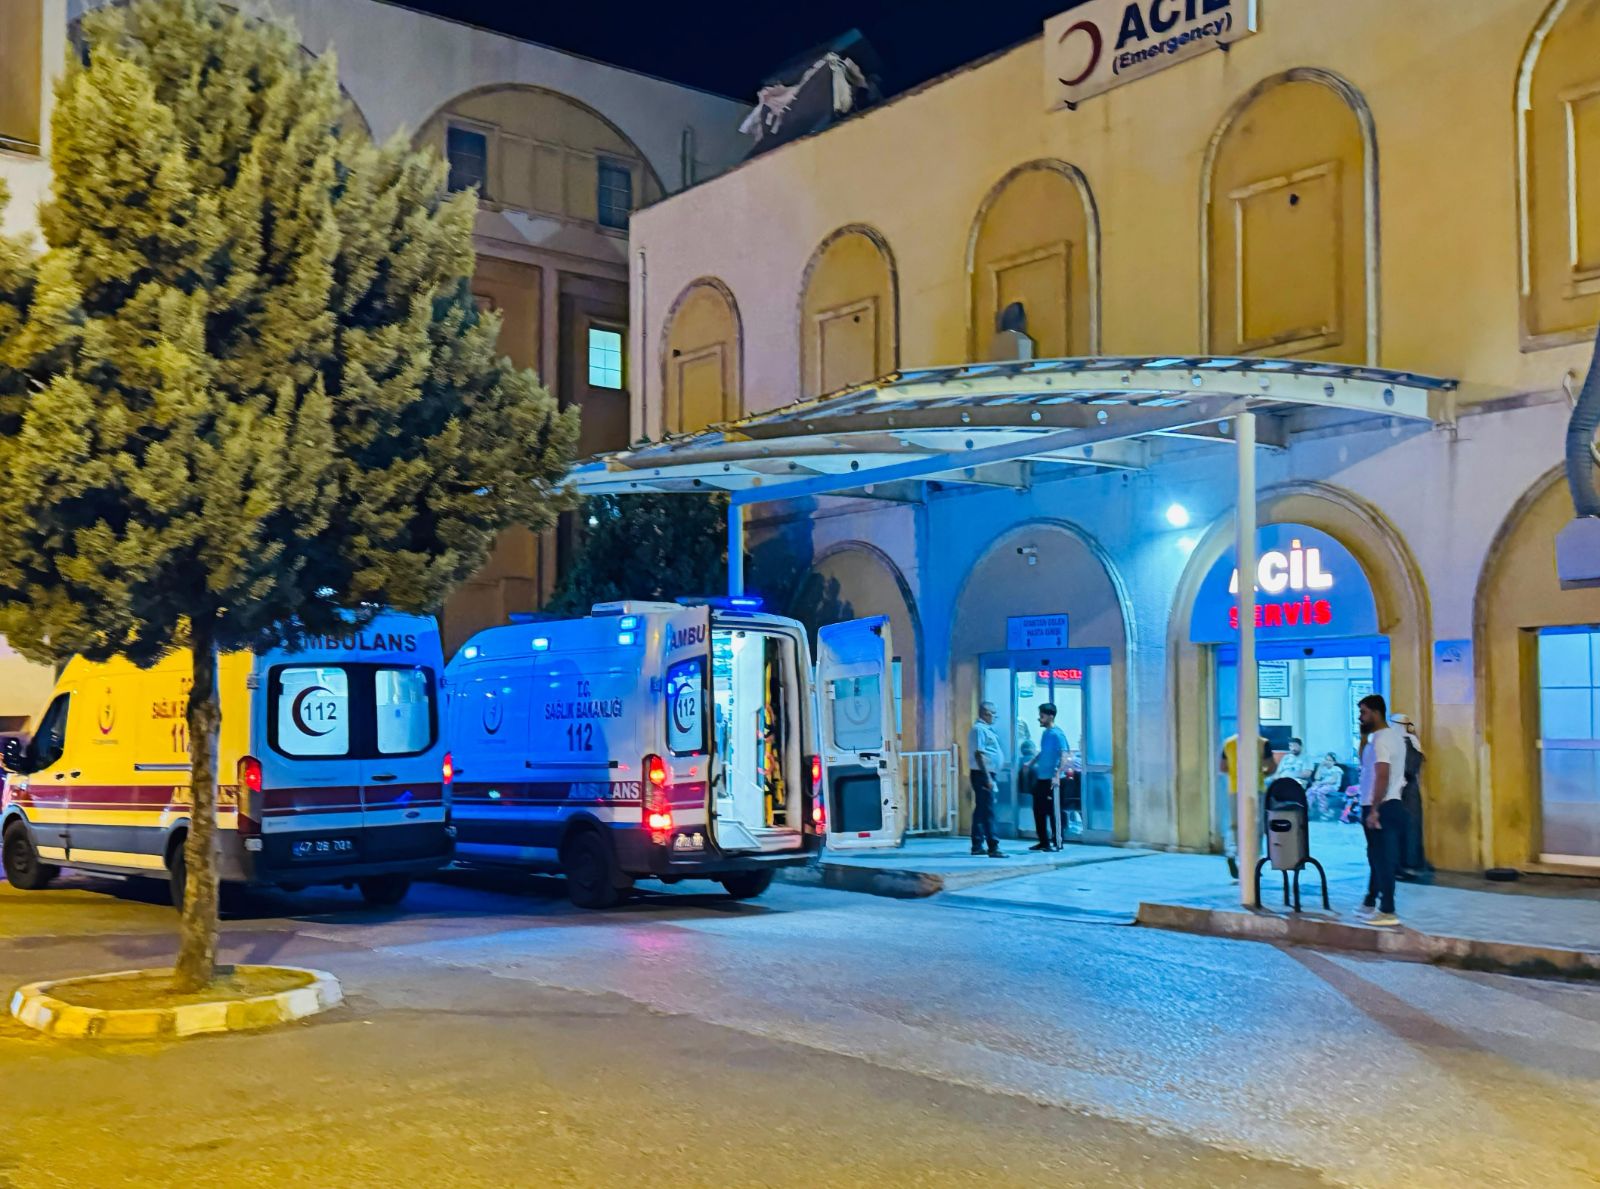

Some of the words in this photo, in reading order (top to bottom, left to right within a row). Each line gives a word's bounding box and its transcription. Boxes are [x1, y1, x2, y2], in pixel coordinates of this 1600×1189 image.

[1112, 12, 1232, 75] (Emergency)
[302, 632, 417, 652] MBULANS
[671, 624, 706, 651] AMBU
[304, 702, 337, 721] 112
[678, 697, 696, 718] 112
[171, 723, 191, 753] 11
[567, 723, 593, 752] 112
